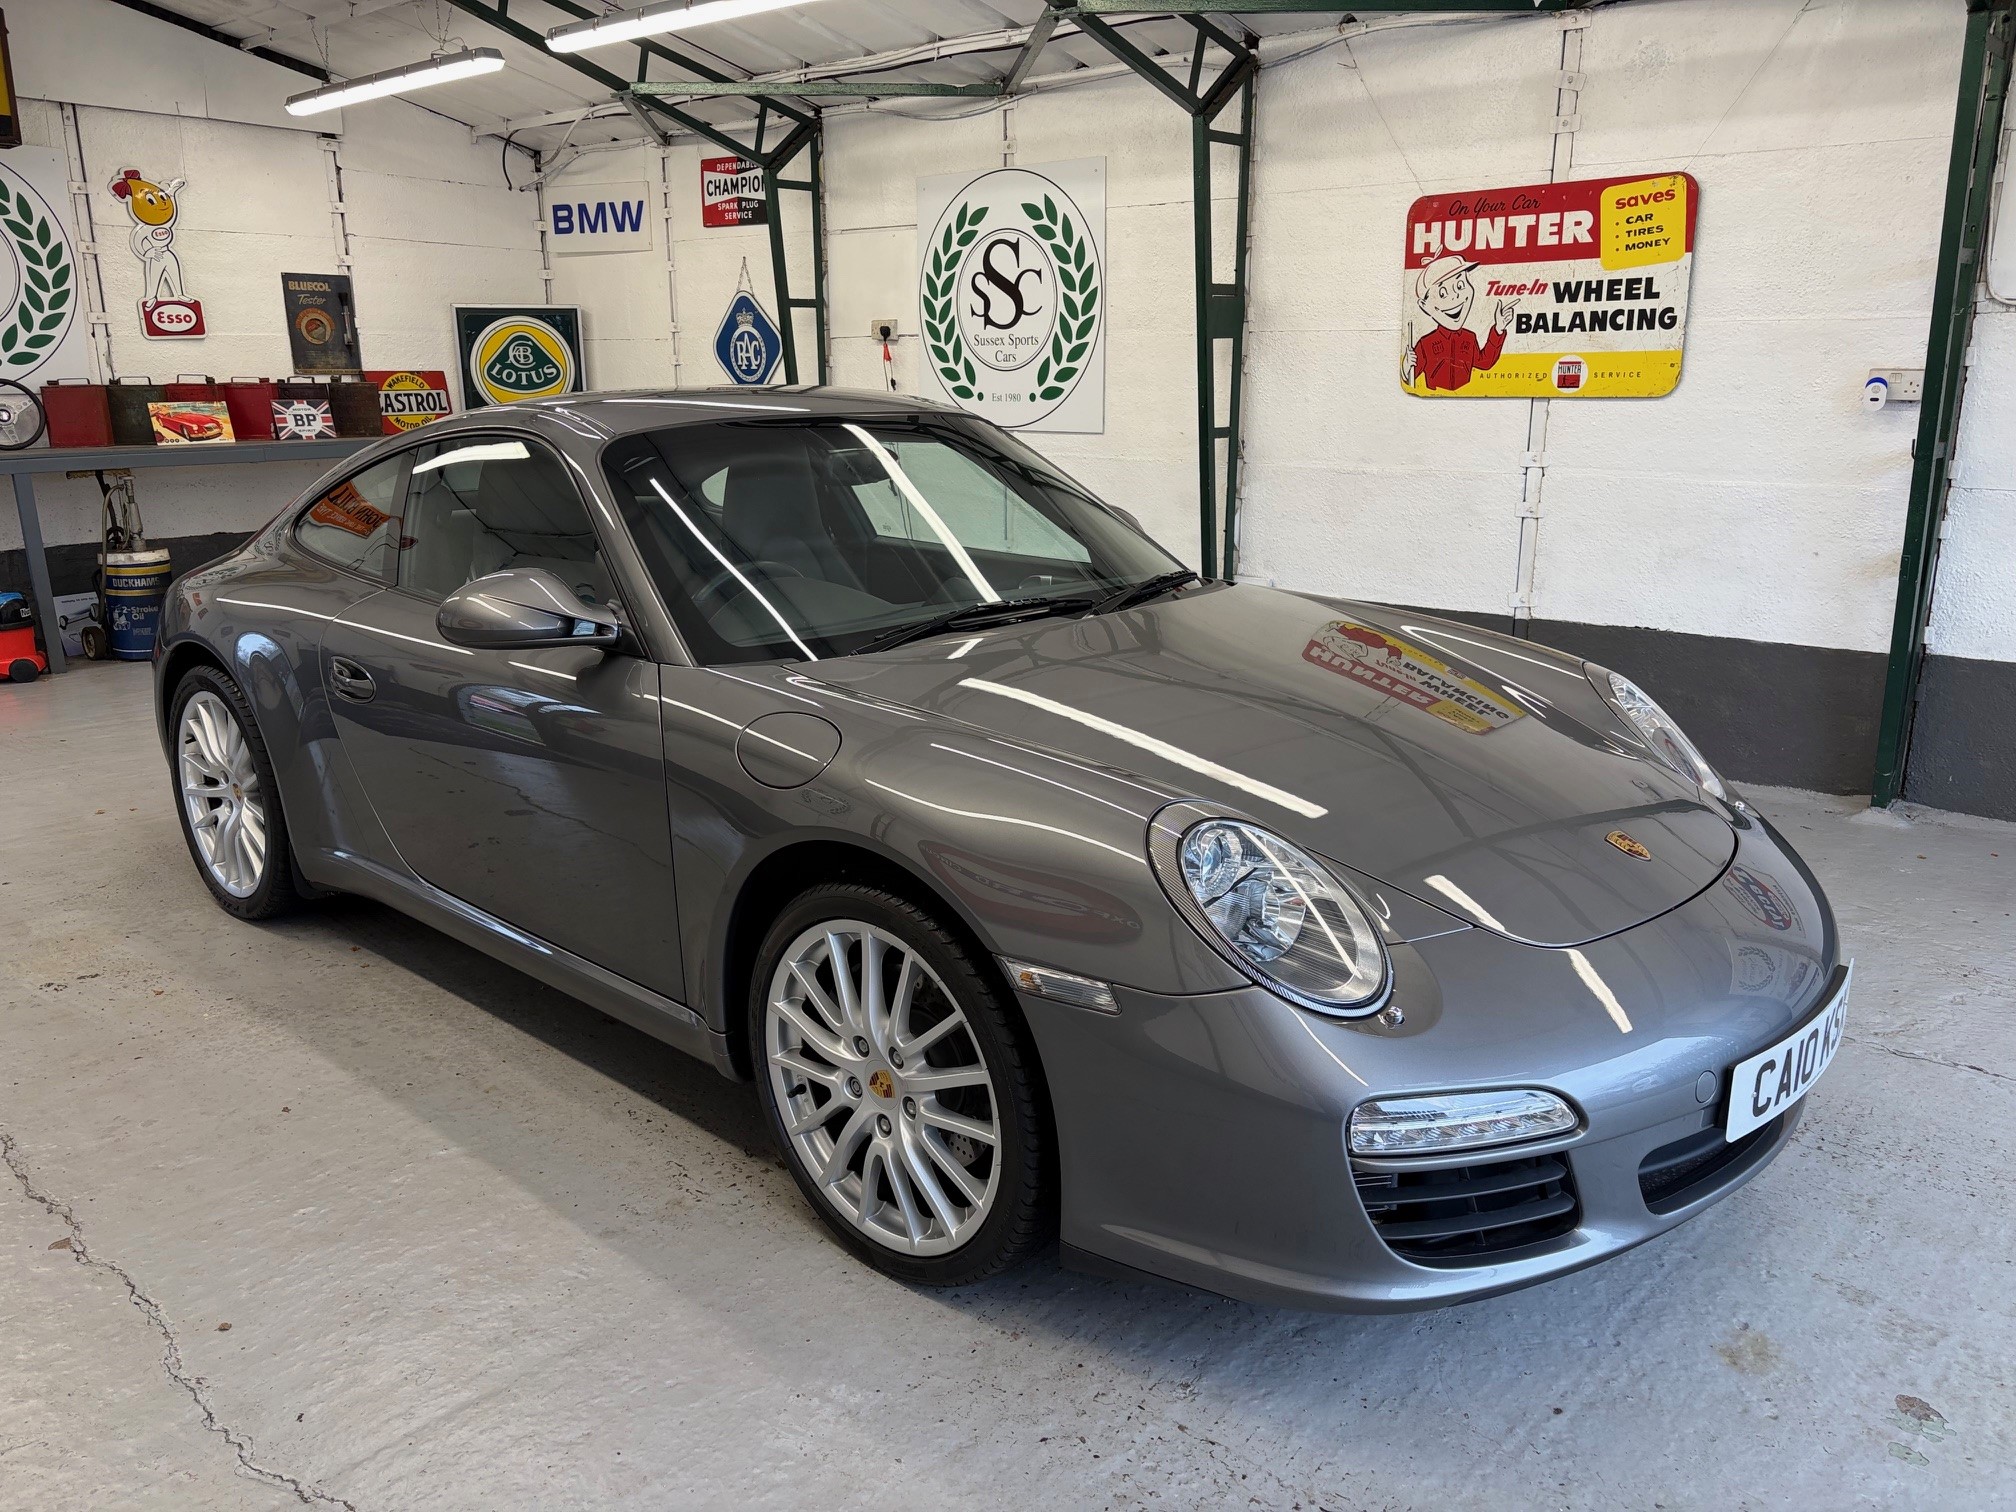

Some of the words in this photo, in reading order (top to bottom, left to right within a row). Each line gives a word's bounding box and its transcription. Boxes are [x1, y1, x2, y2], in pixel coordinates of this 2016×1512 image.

[717, 202, 738, 211] SPARK
[741, 200, 759, 209] PLUG
[1449, 200, 1469, 216] On
[1474, 197, 1506, 218] Your
[1512, 194, 1541, 210] Car
[1615, 189, 1676, 210] saves
[552, 200, 644, 235] BMW
[724, 211, 752, 220] SERVICE
[1625, 213, 1654, 225] CAR
[1413, 210, 1594, 254] HUNTER
[1625, 225, 1664, 238] TIRES
[1625, 237, 1671, 252] MONEY
[288, 280, 331, 292] BLUECOL
[1486, 279, 1548, 297] Tune-In
[1553, 277, 1660, 304] WHEEL
[297, 293, 327, 305] Tester
[157, 311, 193, 324] Esso
[1515, 307, 1677, 334] BALANCING
[973, 334, 1006, 347] Sussex
[1008, 333, 1039, 349] Sports
[736, 333, 760, 369] RAC
[995, 349, 1017, 363] Cars
[490, 363, 557, 386] LOTUS
[1479, 372, 1548, 380] AUTHORIZED
[1557, 364, 1582, 375] HUNTER
[1593, 371, 1642, 379] SERVICE
[386, 375, 425, 389] WAKEFIELD
[381, 392, 447, 413] ASTROL
[991, 392, 1003, 402] Est
[1004, 392, 1021, 402] 1980
[421, 416, 432, 426] OIL
[112, 577, 160, 588] DUCKHAMS
[122, 605, 159, 614] 2-Stroke
[1752, 1028, 1819, 1118] CA10
